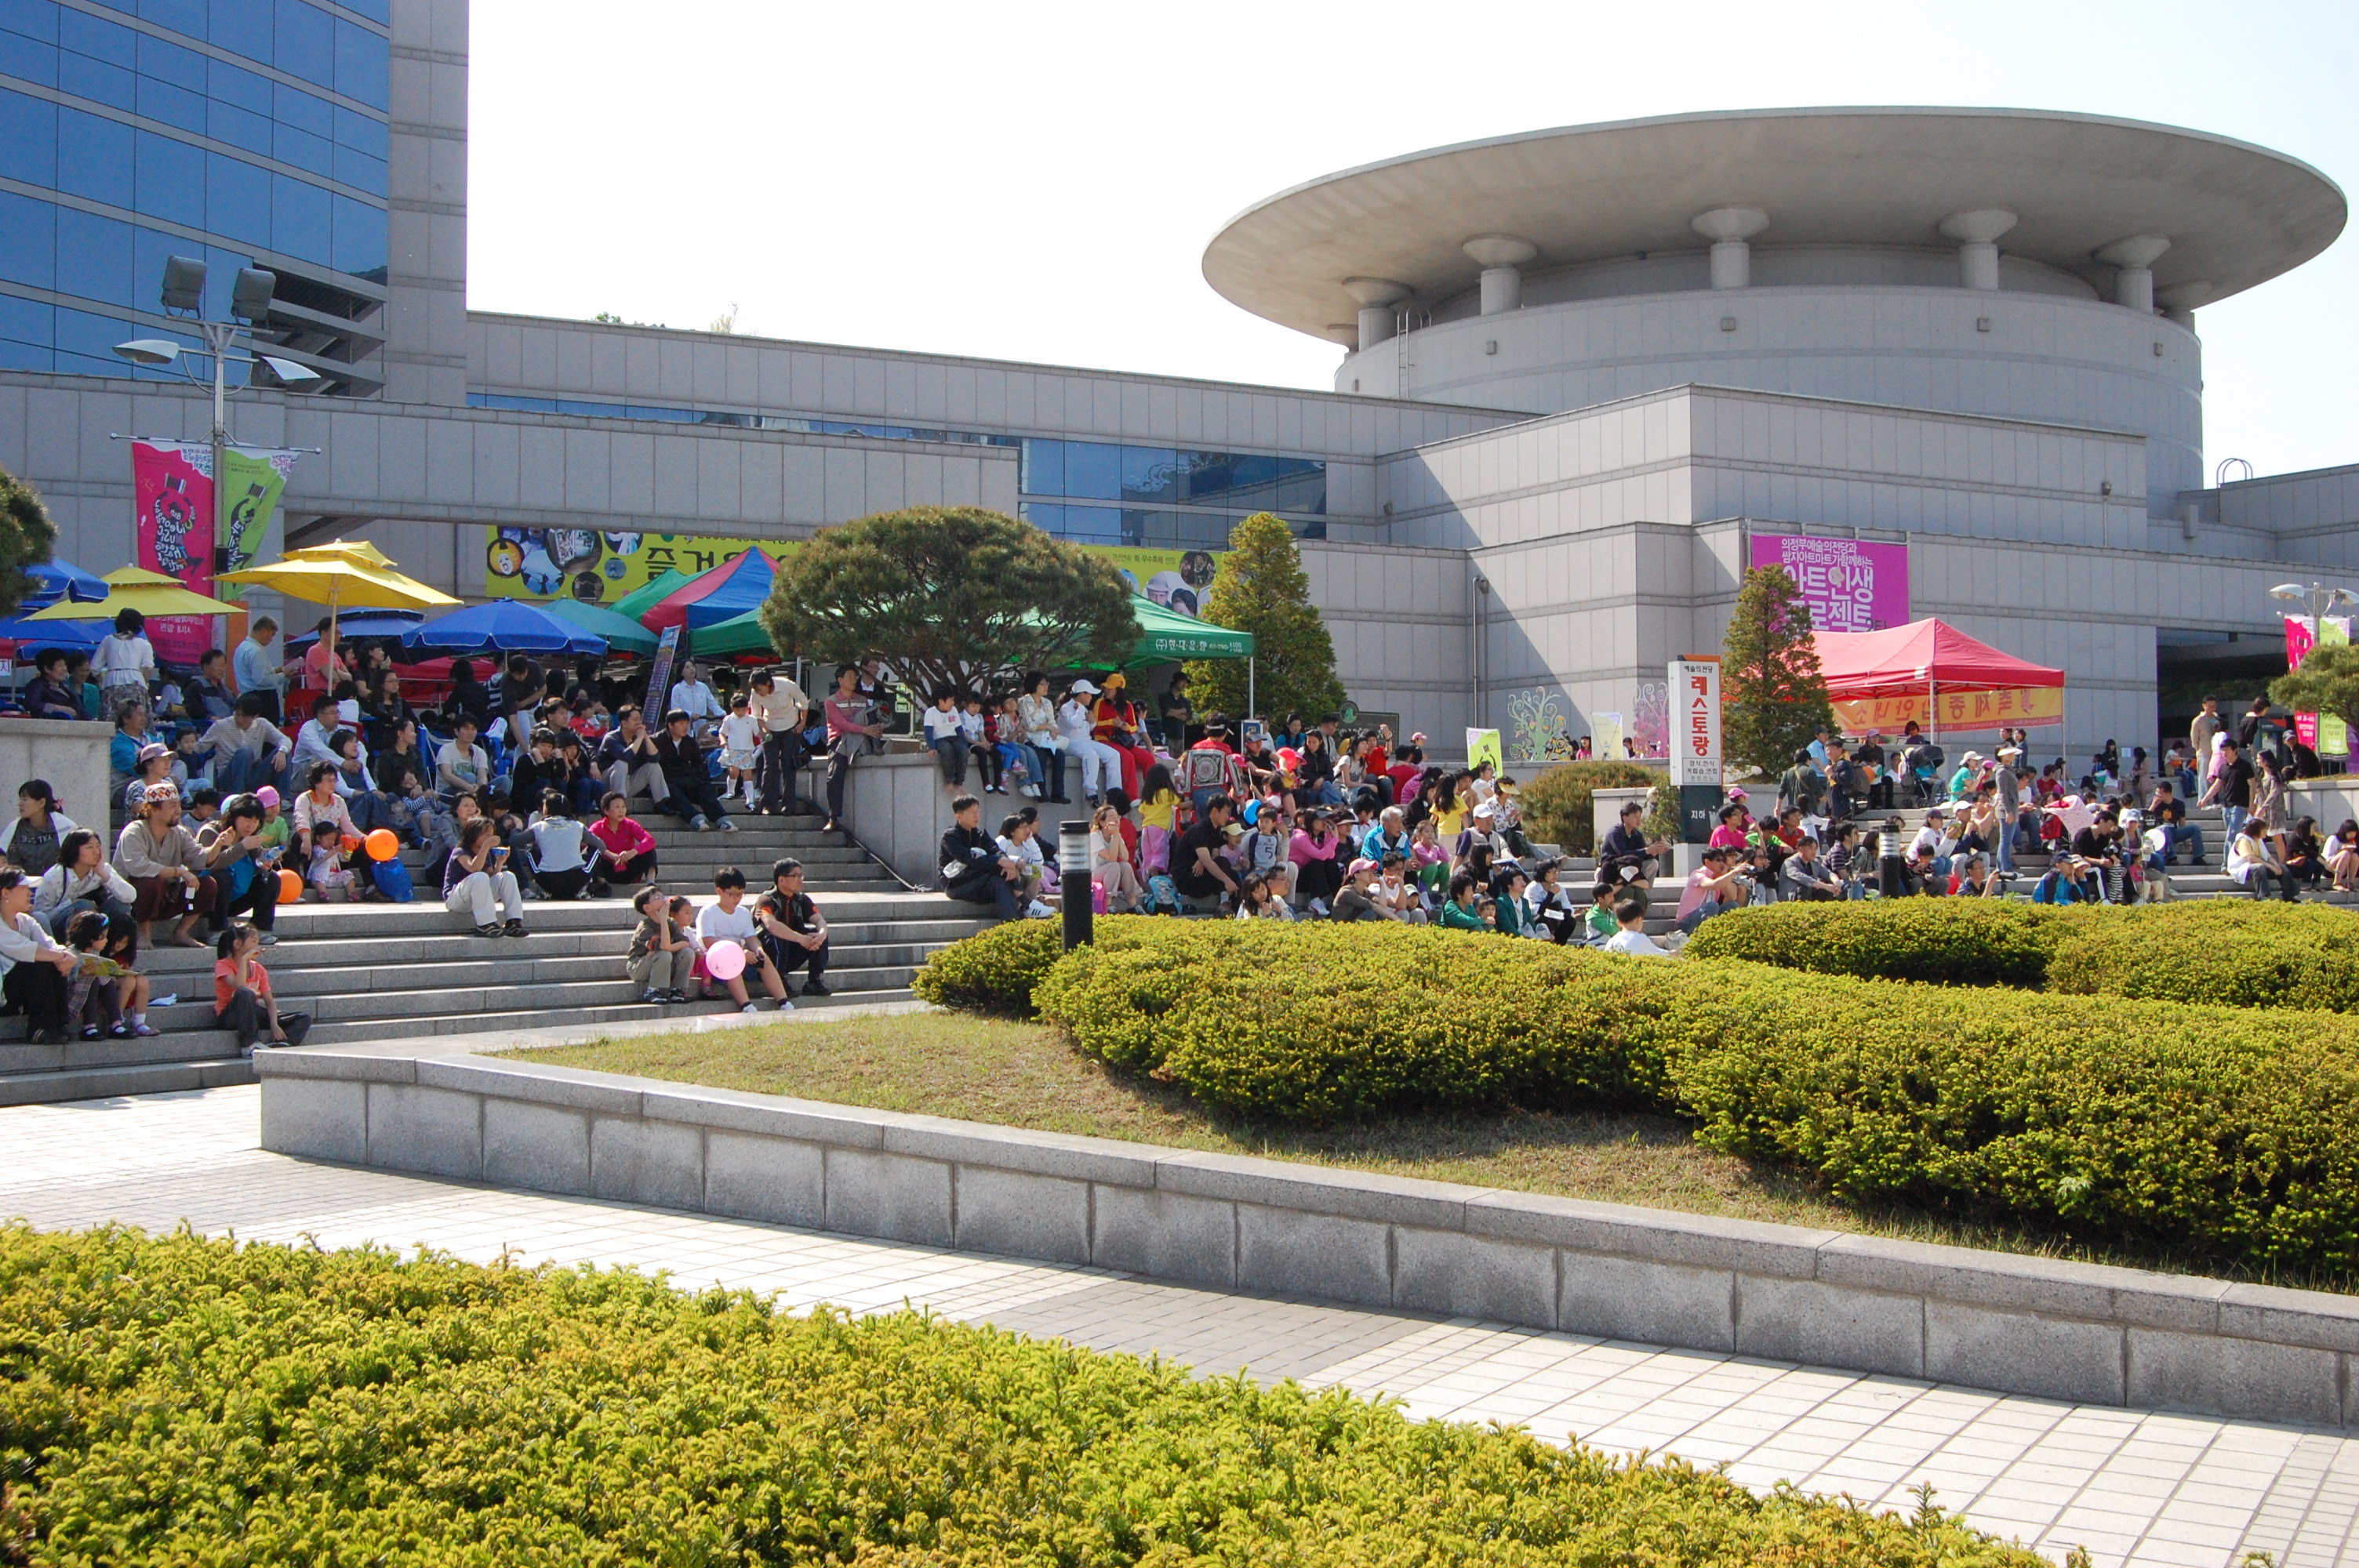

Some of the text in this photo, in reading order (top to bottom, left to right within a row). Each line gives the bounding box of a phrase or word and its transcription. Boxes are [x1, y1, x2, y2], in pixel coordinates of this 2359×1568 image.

[1781, 538, 1857, 554] 의정부예술의전당과
[1783, 562, 1874, 603] 아트인생
[1787, 601, 1874, 633] 로젝트
[1691, 675, 1710, 757] 레스토랑
[1264, 846, 1274, 860] 5
